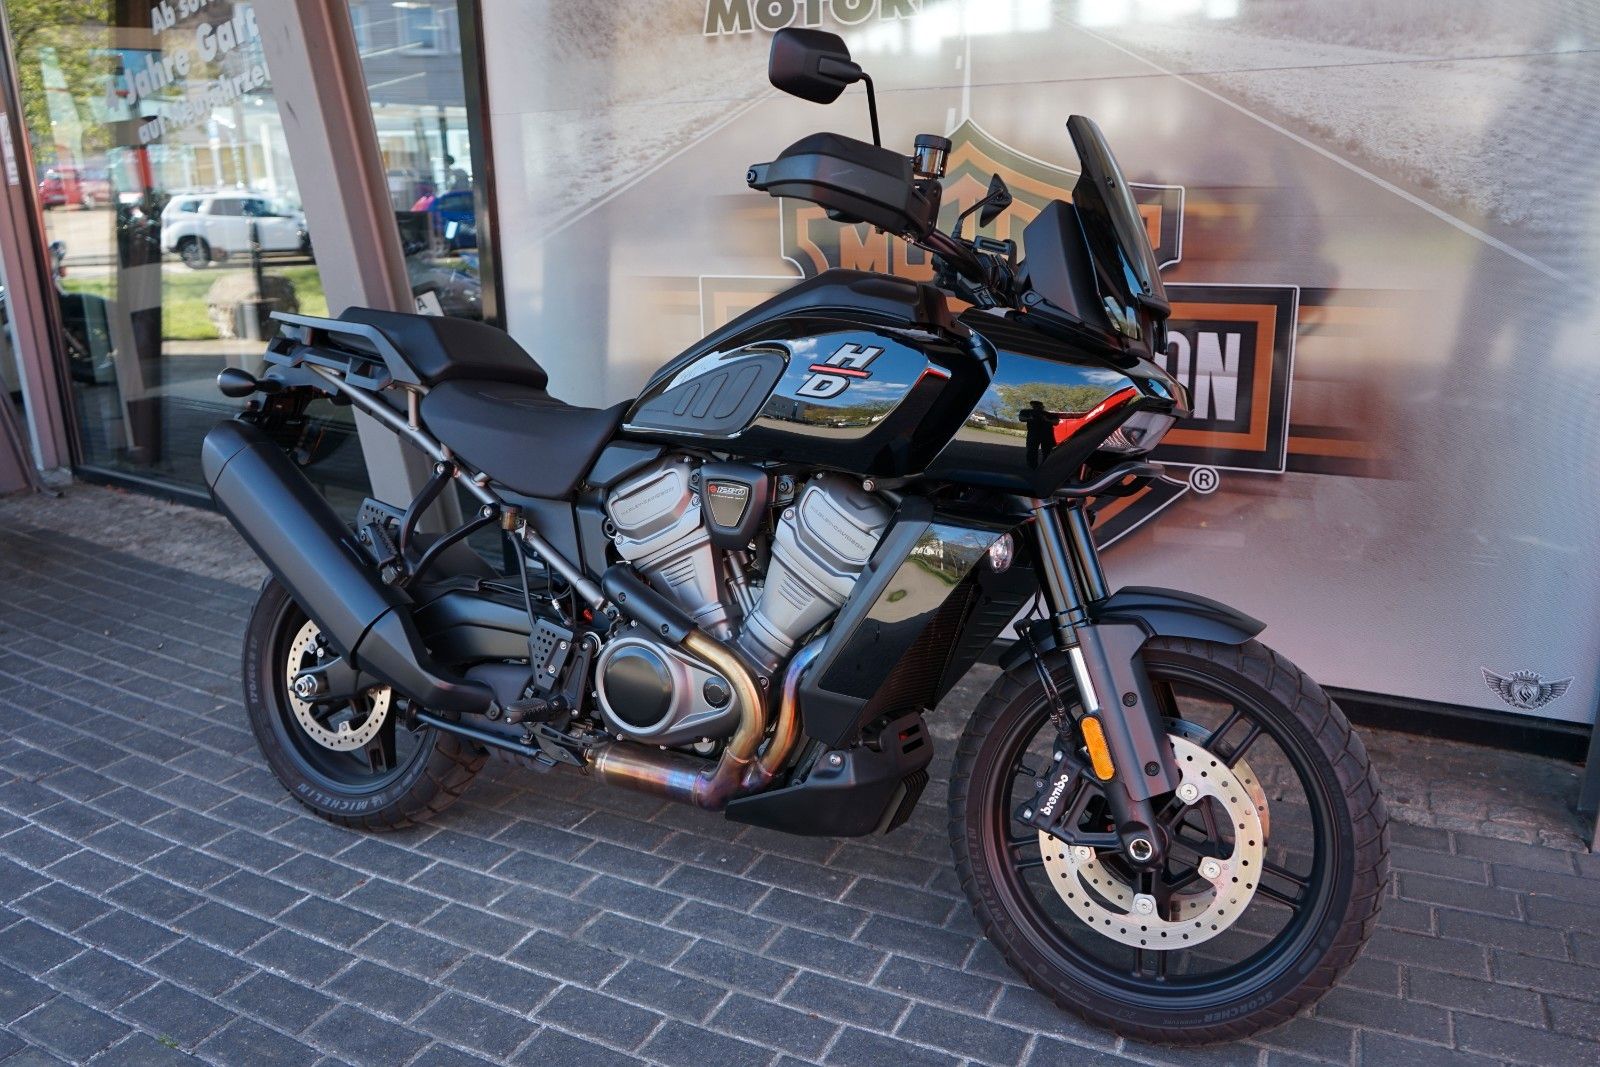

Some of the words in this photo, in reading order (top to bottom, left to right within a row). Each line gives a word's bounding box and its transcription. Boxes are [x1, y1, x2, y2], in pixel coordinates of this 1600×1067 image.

[151, 0, 176, 35] Ab
[123, 49, 190, 105] Jahre
[824, 342, 885, 371] H
[795, 373, 850, 399] D
[296, 782, 370, 811] MICHELIN
[1040, 774, 1069, 816] brembo
[1202, 990, 1274, 1022] SCORCHER
